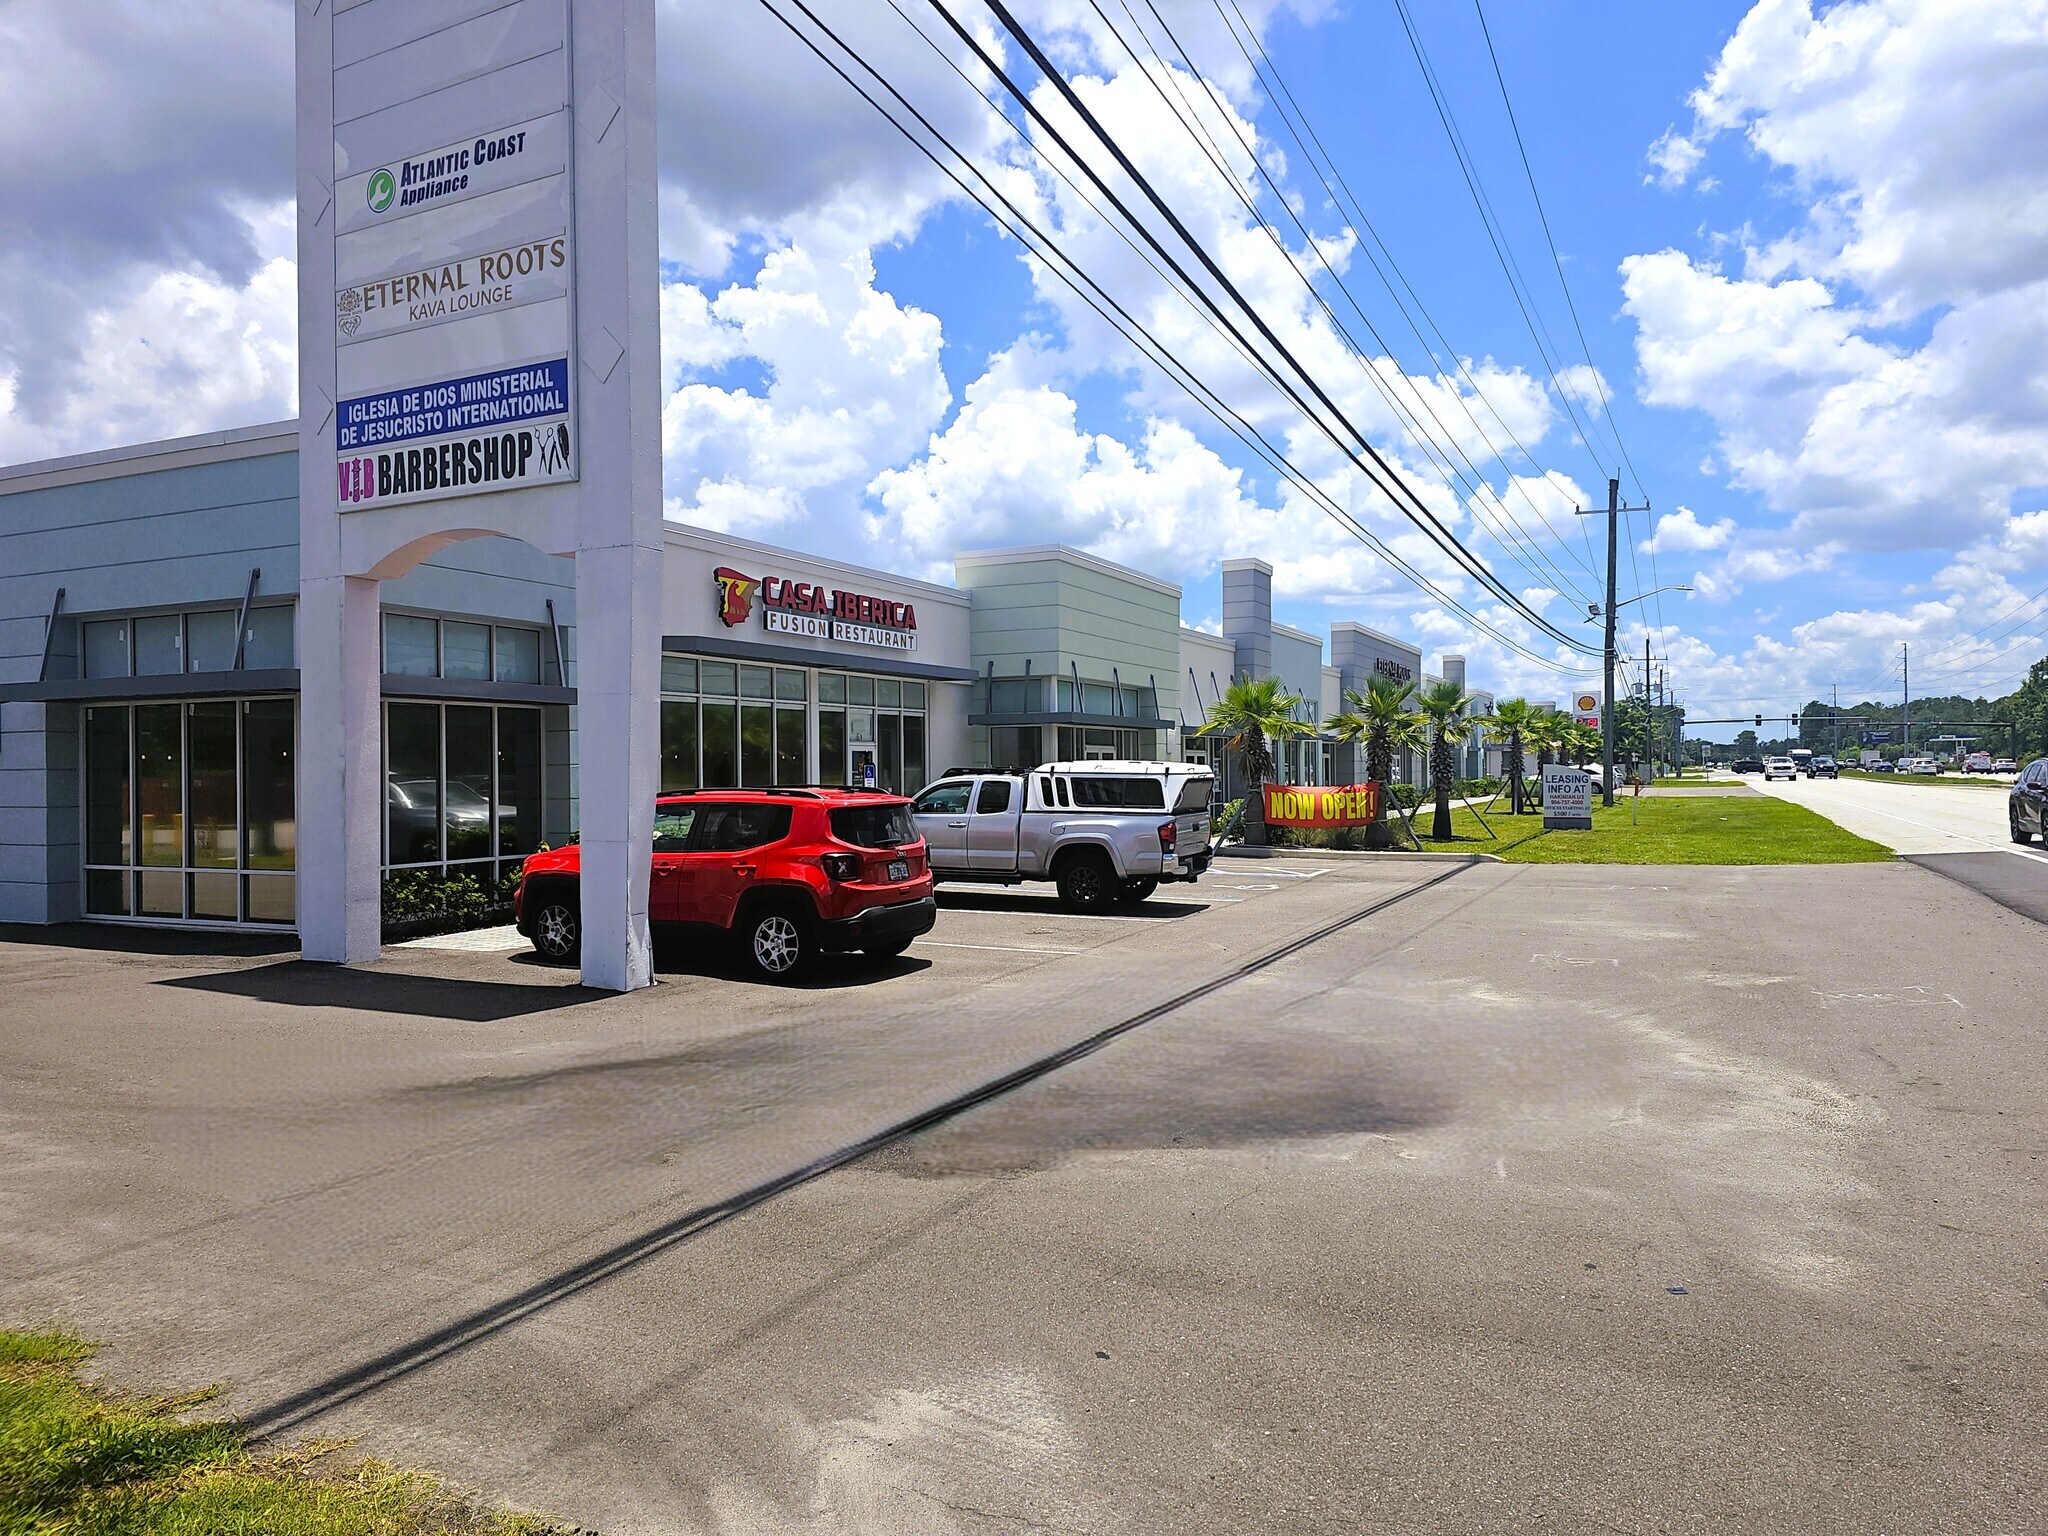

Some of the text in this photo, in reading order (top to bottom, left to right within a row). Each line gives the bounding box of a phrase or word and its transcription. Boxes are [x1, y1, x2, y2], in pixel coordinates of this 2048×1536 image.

[401, 131, 526, 187] ATLANTIC COAST
[400, 174, 469, 206] Appliance
[363, 239, 566, 312] ETERNAL ROOTS
[409, 284, 513, 321] KAVA LOUNGE
[341, 389, 564, 446] DE JESUCRISTO INTERNATIONAL
[348, 368, 553, 424] IGLESIA DE DIOS MINISTERIAL
[378, 431, 533, 496] BARBERSHOP
[762, 576, 917, 630] CASA IBERICA
[770, 613, 914, 650] FUSION RESTAURANT
[1545, 774, 1589, 784] LEASING
[1547, 784, 1587, 794] INFO AT
[1270, 791, 1315, 820] NOW
